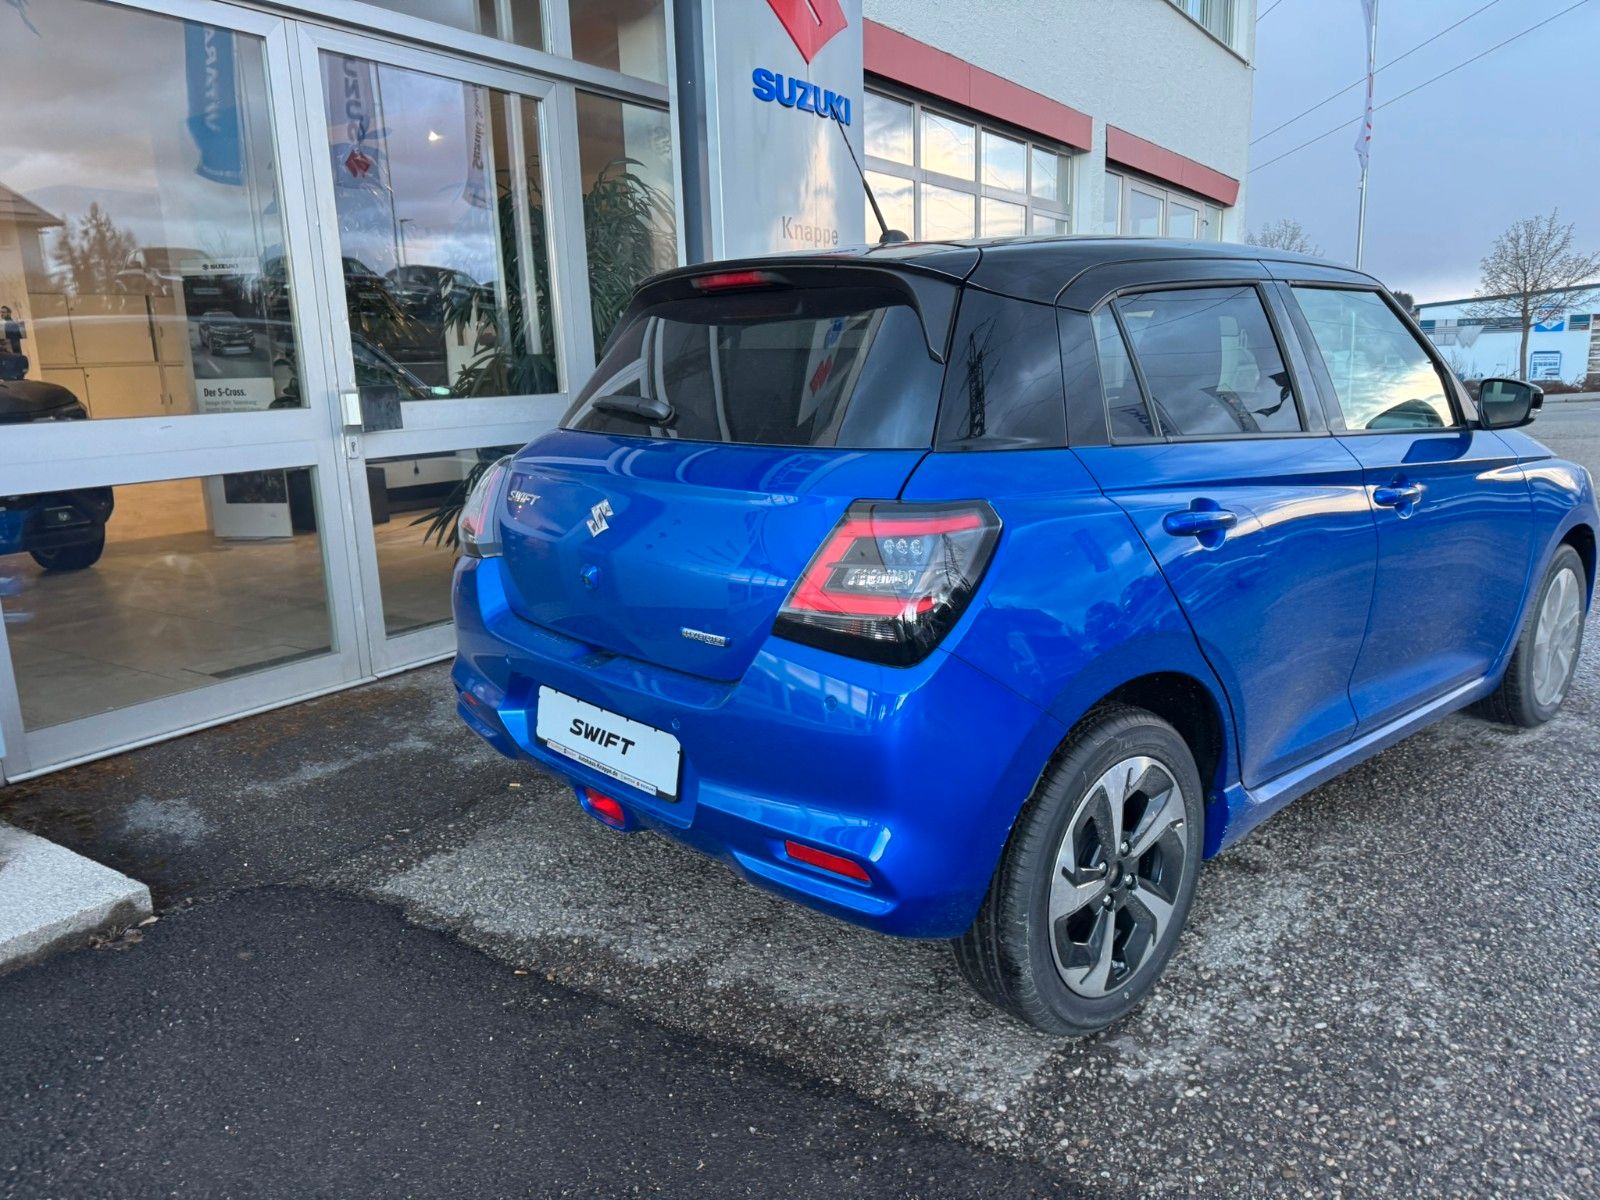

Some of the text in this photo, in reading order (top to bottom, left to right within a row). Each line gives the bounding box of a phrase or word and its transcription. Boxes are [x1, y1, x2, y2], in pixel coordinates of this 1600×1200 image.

[752, 67, 851, 126] SUZUKI
[781, 215, 839, 247] Knappe
[203, 387, 247, 397] Der S-Cross.
[508, 490, 541, 505] SWIFT
[569, 718, 635, 756] SWIFT
